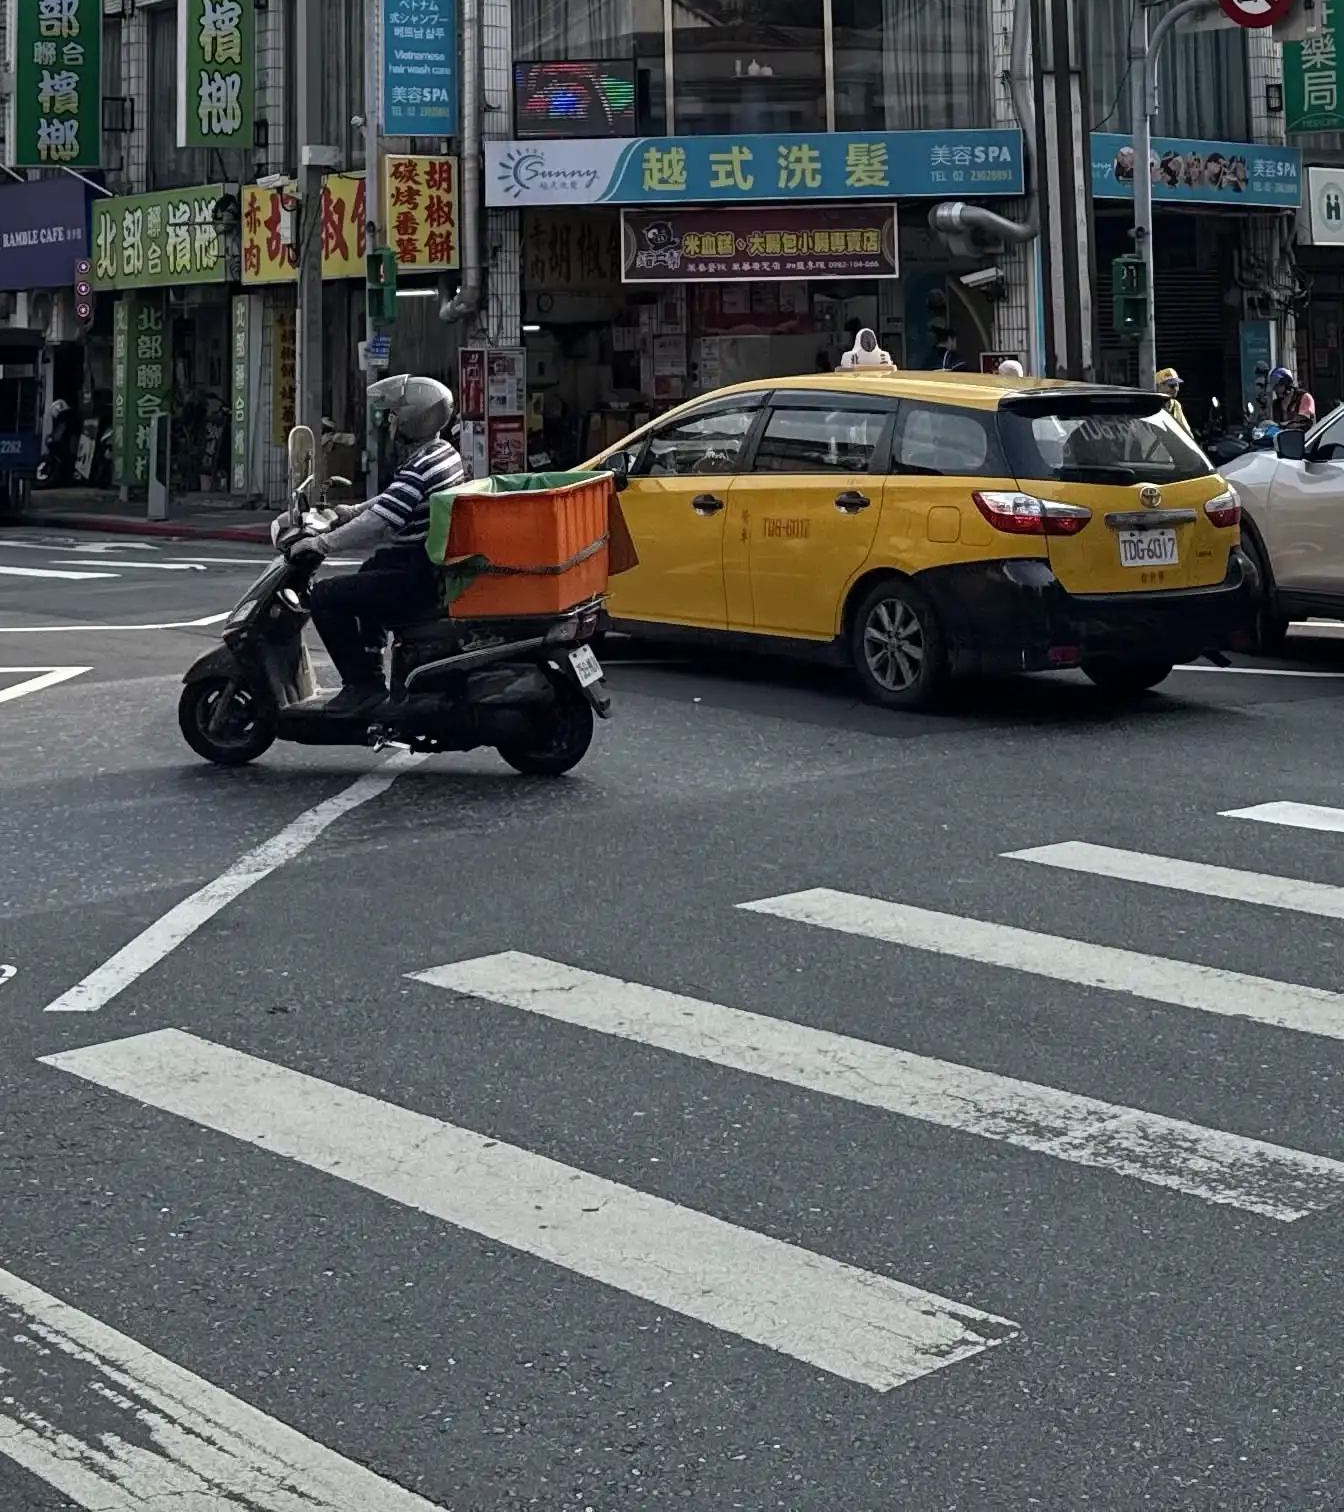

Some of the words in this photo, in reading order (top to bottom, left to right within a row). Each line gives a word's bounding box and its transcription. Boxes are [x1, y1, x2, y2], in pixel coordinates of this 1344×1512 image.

[394, 49, 446, 62] Vietnamese
[391, 86, 449, 104] 美容SPA
[930, 145, 1011, 166] 美容SPA
[525, 161, 600, 188] Sunny
[642, 141, 890, 192] 越式洗髮
[931, 170, 947, 182] TEL
[953, 170, 964, 182] 02
[1253, 159, 1297, 178] 美容SPA
[390, 159, 423, 264] 碳烤番薯
[423, 160, 456, 265] 胡椒餅
[2, 231, 38, 248] RAMBLE
[39, 226, 65, 241] CAFE
[243, 190, 262, 277] 赤肉
